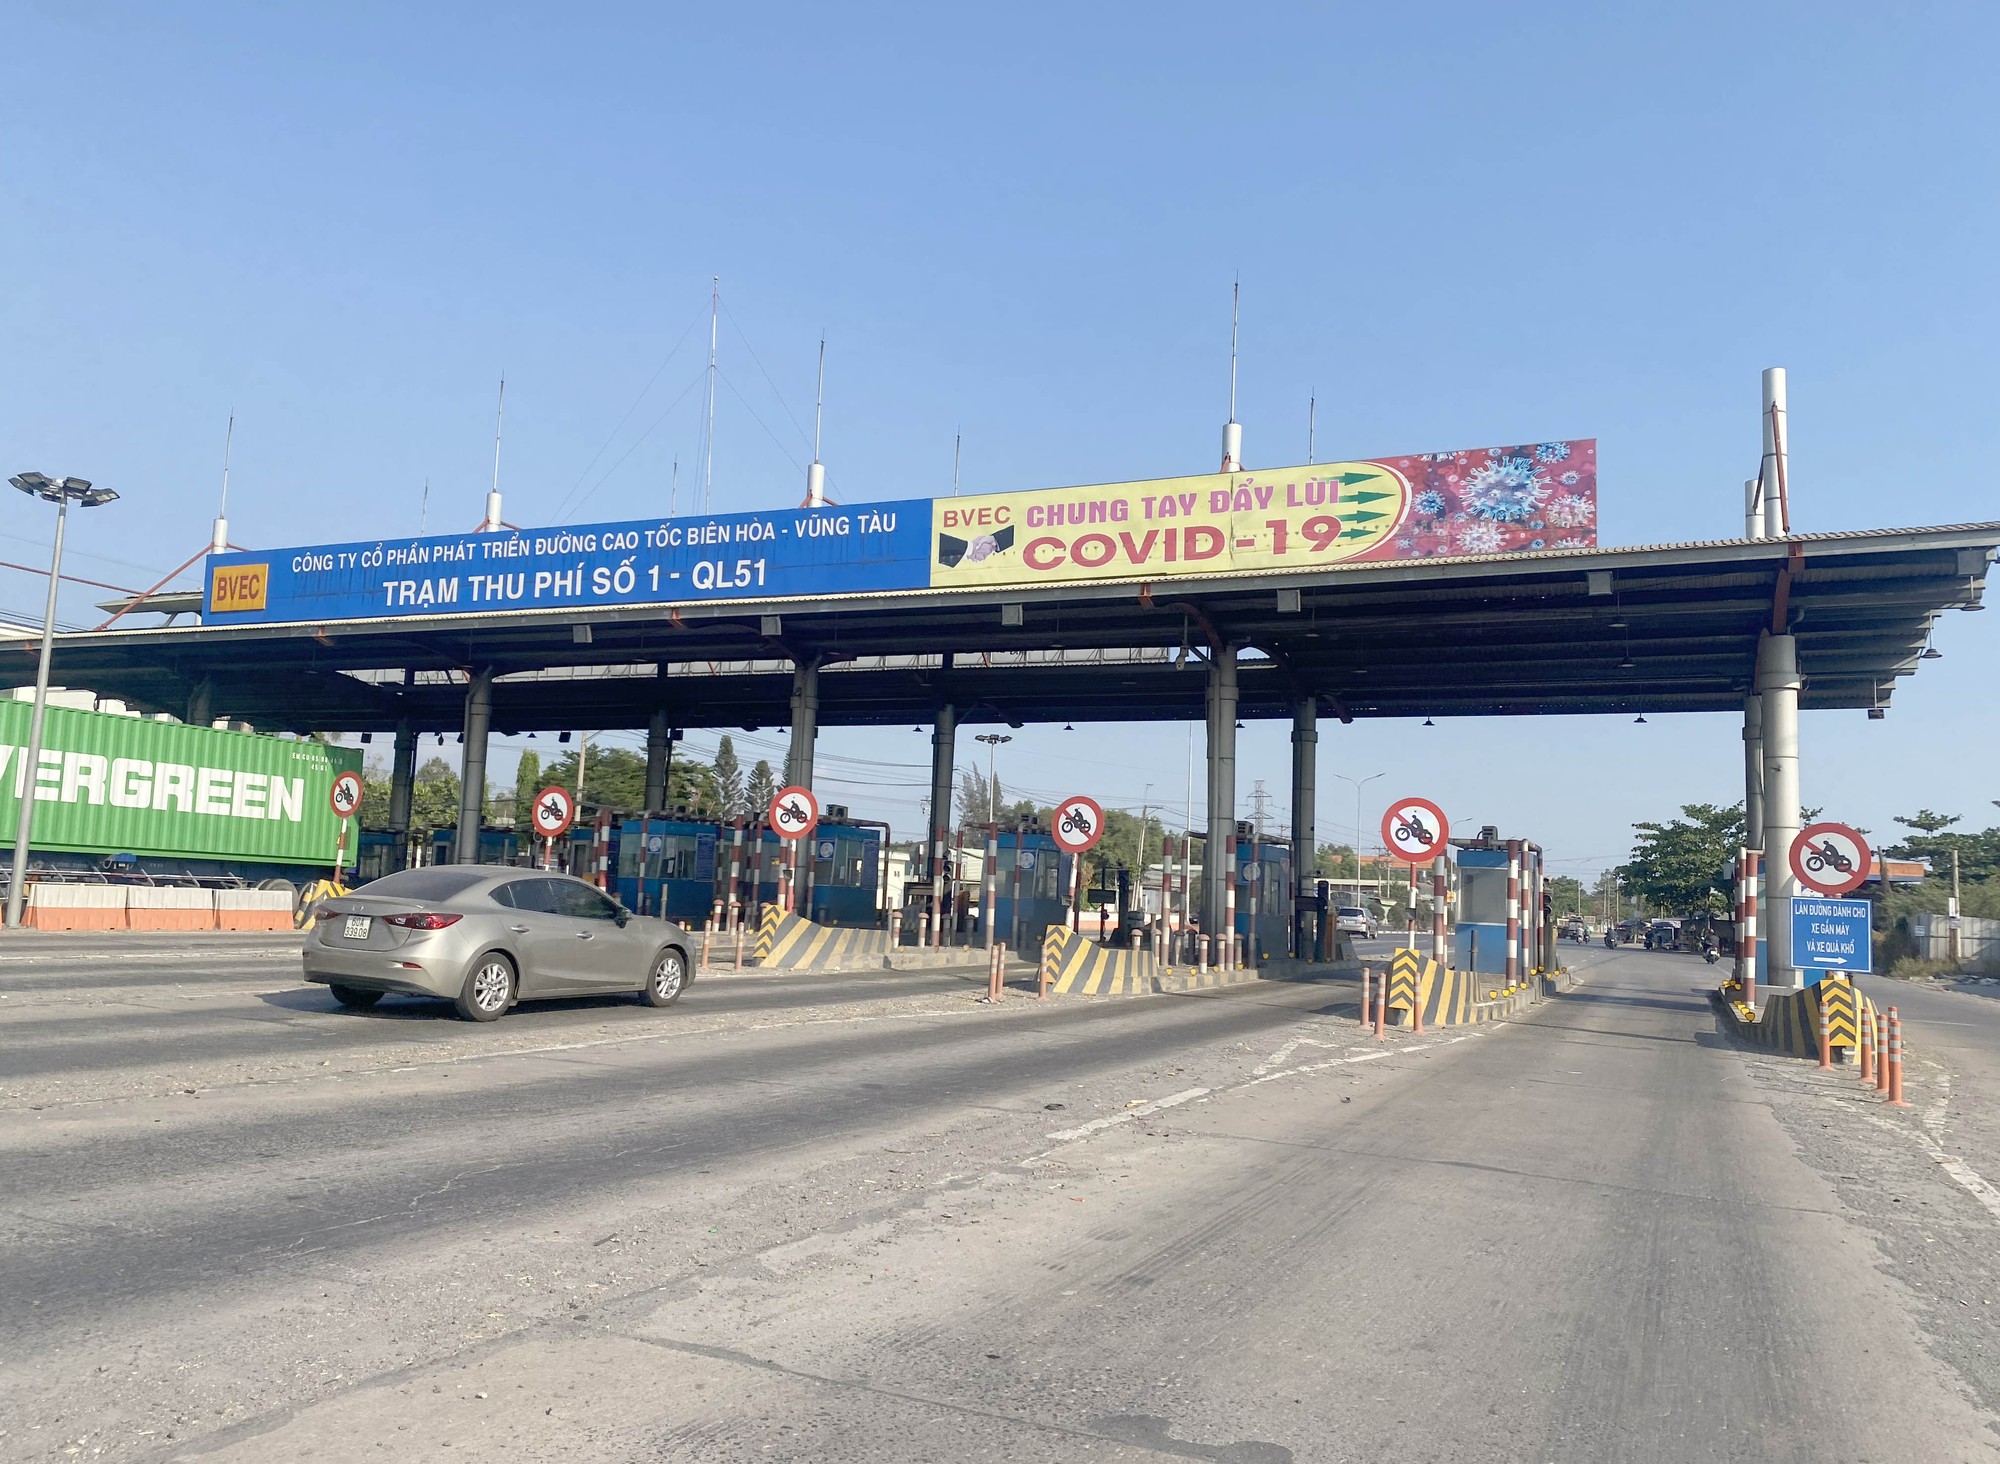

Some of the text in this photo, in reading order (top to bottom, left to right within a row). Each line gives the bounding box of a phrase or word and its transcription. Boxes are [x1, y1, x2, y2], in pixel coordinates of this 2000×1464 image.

[1026, 477, 1340, 528] CHUNG TAY ĐẨY LÙI
[943, 505, 1011, 528] BVEC
[292, 552, 334, 573] CÔNG
[337, 552, 358, 569] TY
[361, 541, 384, 568] CỔ
[386, 541, 429, 566] PHẦN
[433, 540, 476, 563] PHÁT
[481, 532, 530, 559] TRIỂN
[535, 530, 597, 556] ĐƯỜNG
[601, 531, 639, 551] CAO
[645, 522, 682, 547] TỐC
[686, 520, 731, 546] BIÊN
[735, 517, 776, 542] HÒA
[794, 513, 850, 538] VŨNG
[857, 510, 896, 534] TÀU
[1022, 514, 1342, 571] COVID-19
[216, 574, 260, 601] BVEC
[382, 577, 459, 608] TRẠM
[468, 572, 525, 602] THU
[533, 562, 585, 598] PHÍ
[592, 555, 637, 595] SỐ
[648, 564, 660, 592] 1
[692, 558, 766, 590] QL51
[1794, 902, 1808, 915] LÀN
[1833, 903, 1852, 918] DÀNH
[1852, 907, 1866, 918] CHO
[1811, 922, 1820, 934] XE
[1835, 922, 1850, 935] MÁY
[1806, 938, 1855, 954] VÀ XE QUÁ KHỔ
